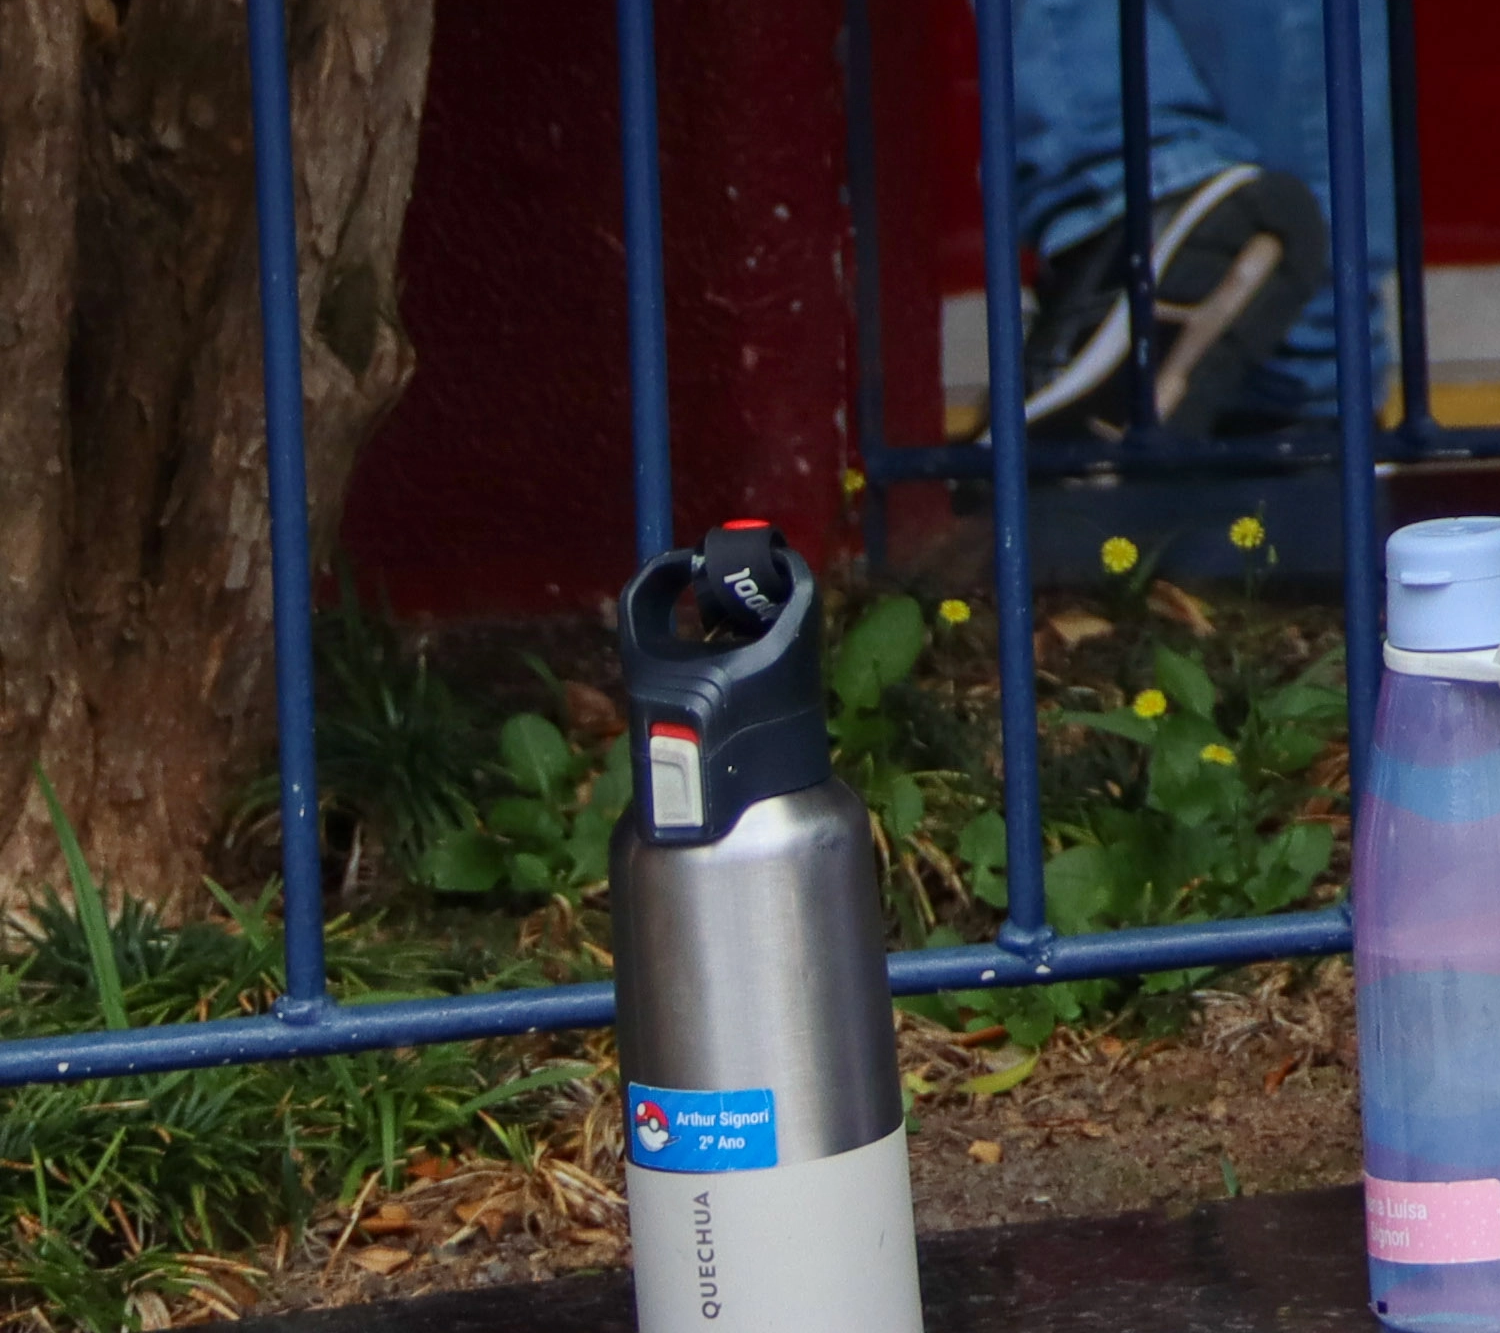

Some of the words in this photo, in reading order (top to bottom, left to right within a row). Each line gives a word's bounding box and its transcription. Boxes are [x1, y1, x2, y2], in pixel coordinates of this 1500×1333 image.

[676, 1111, 716, 1127] Arthur
[719, 1109, 769, 1129] Signori
[718, 1136, 746, 1150] Ano
[693, 1191, 722, 1320] QUECHUA
